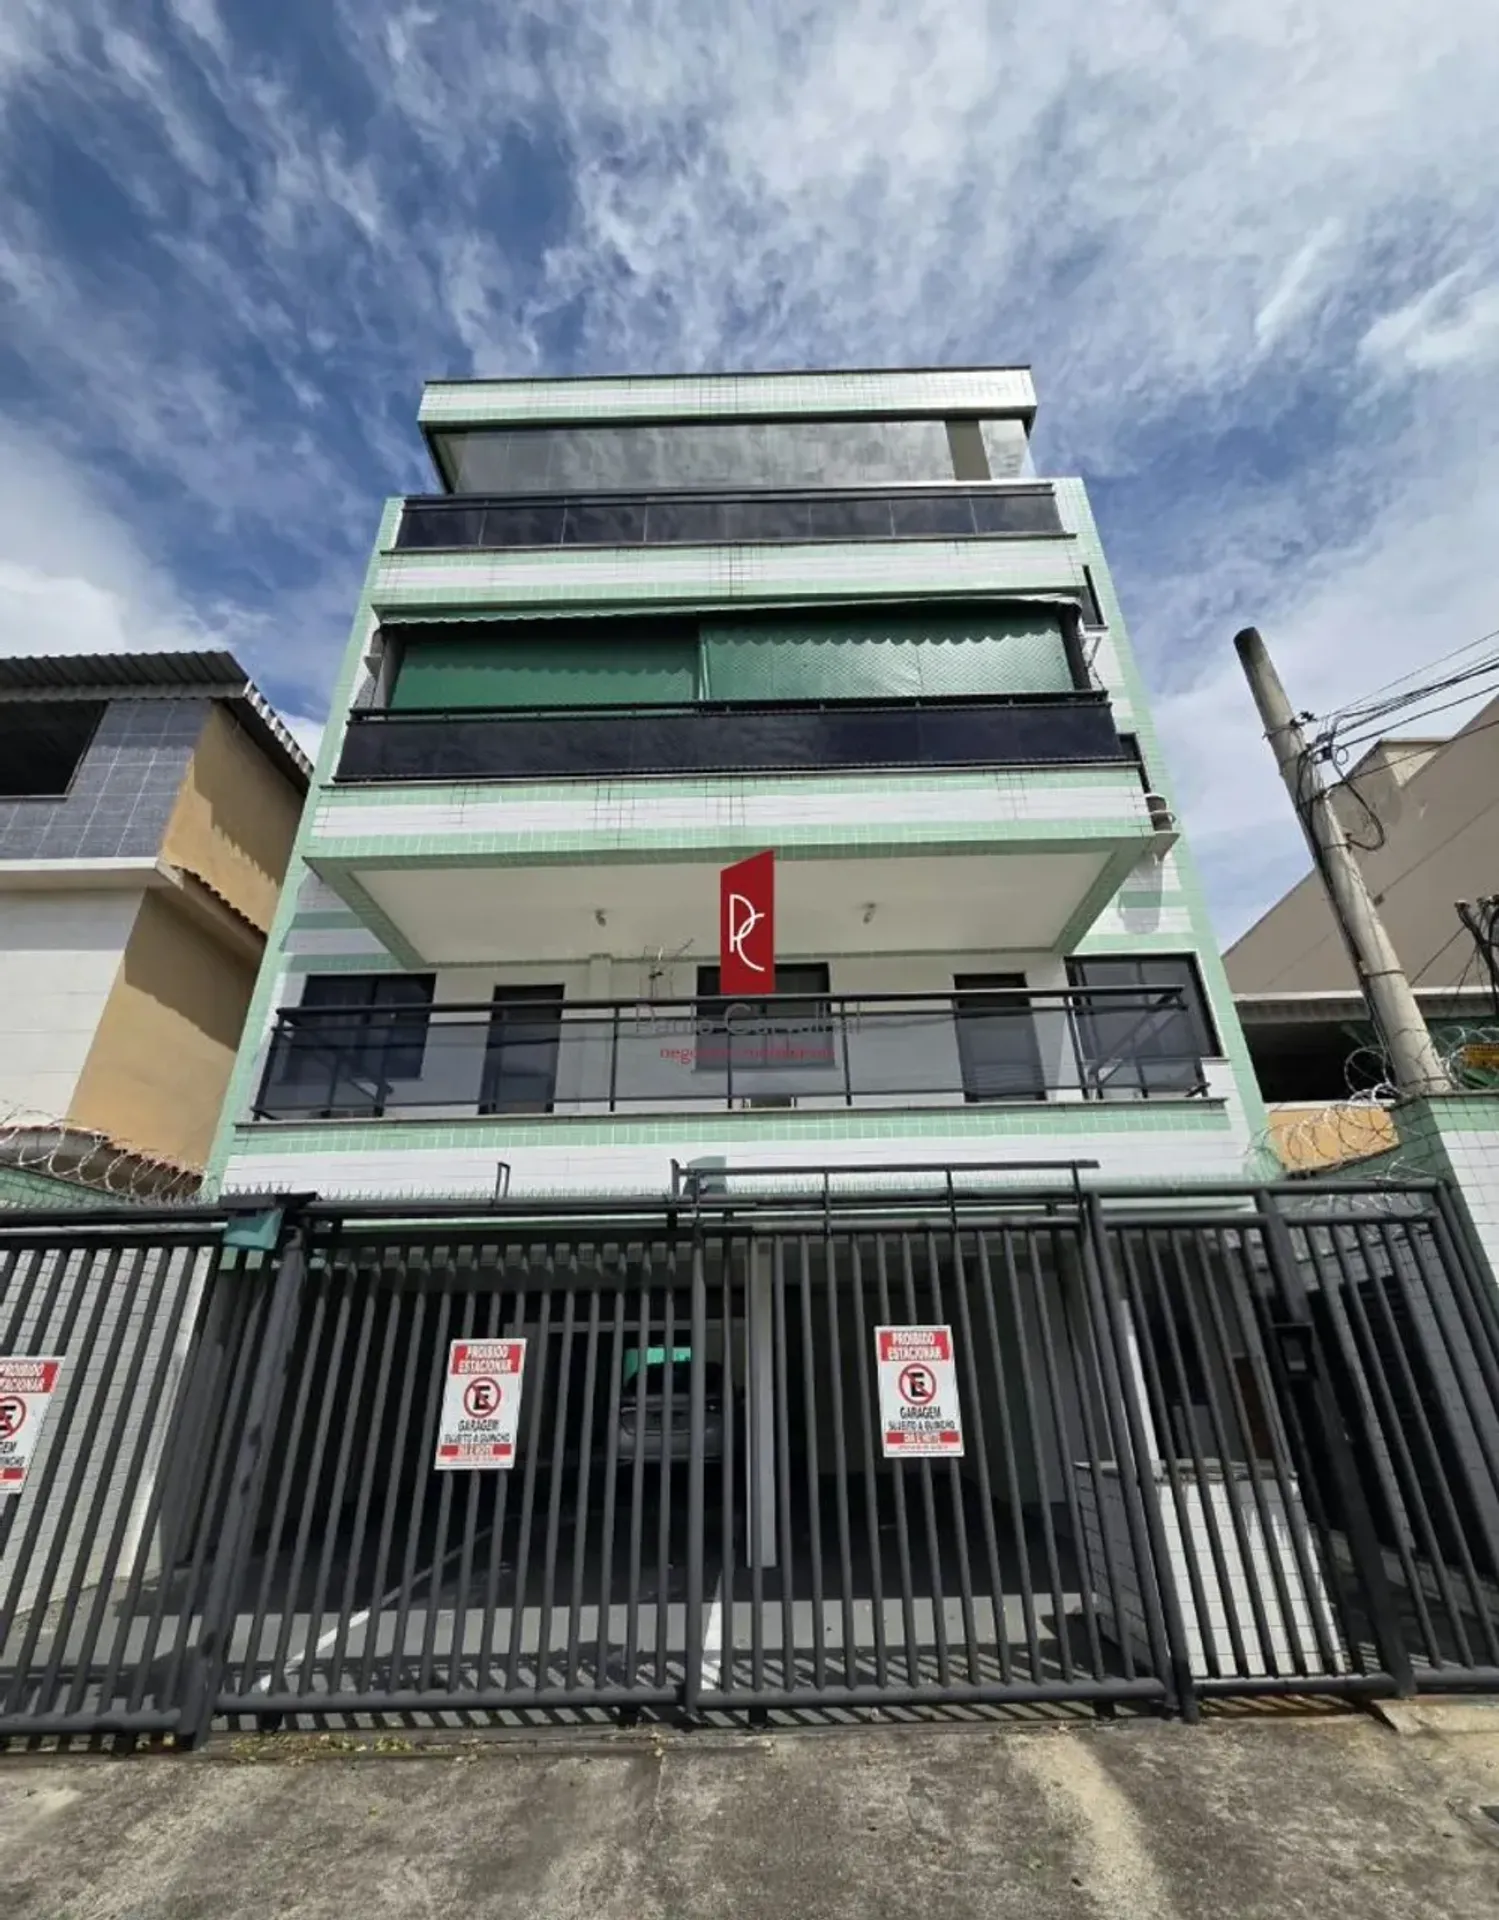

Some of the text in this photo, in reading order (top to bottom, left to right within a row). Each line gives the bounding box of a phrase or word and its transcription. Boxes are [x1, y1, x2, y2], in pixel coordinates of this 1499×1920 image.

[892, 1331, 935, 1345] PROIBIDO
[466, 1345, 509, 1359] PROIBIDO
[887, 1345, 942, 1360] ESTACIONAR
[458, 1359, 512, 1373] ESTACIONAR
[900, 1406, 941, 1419] GARAGEM
[458, 1419, 500, 1432] GARAGEM
